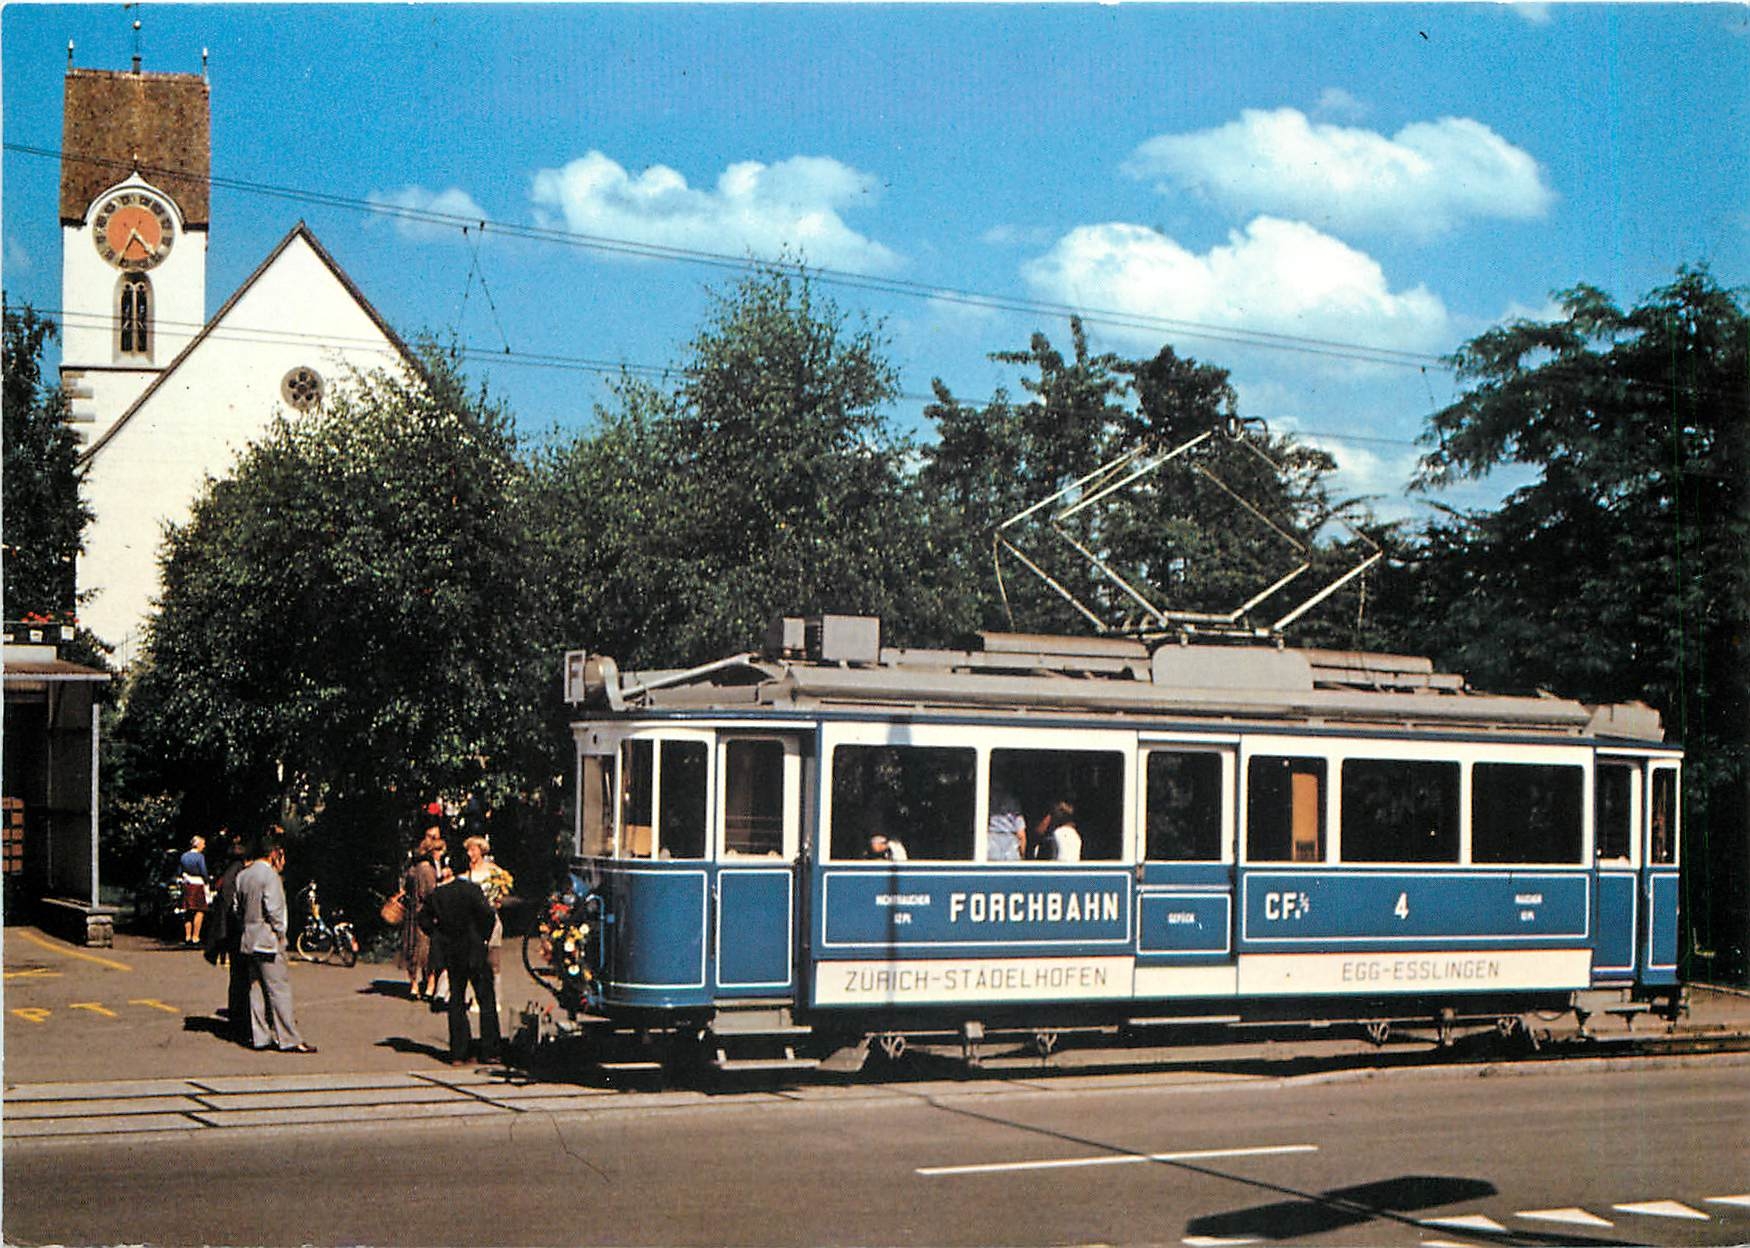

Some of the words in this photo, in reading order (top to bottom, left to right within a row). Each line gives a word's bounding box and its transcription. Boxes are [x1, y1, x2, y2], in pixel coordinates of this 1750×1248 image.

[950, 892, 1119, 922] FORCHBAHN
[1394, 892, 1410, 920] 4
[1342, 960, 1499, 982] EGG-ESSLINGEN
